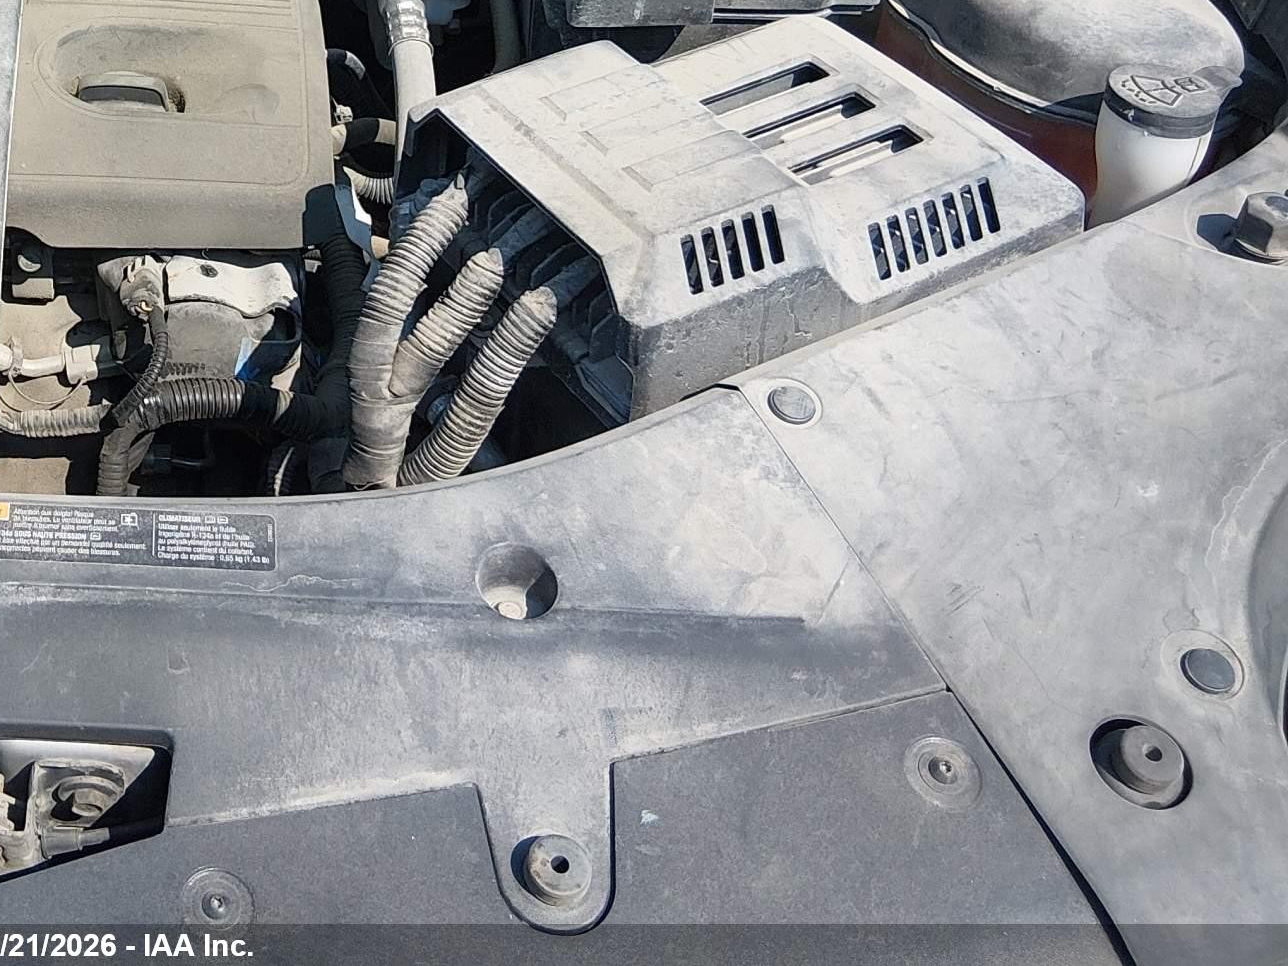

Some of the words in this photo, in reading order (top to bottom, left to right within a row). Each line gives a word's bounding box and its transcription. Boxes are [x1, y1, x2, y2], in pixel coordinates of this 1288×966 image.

[158, 514, 201, 523] CLIMATISEUR
[14, 530, 32, 538] SOUS
[32, 531, 54, 539] HAUTE
[54, 532, 86, 540] PRESSION
